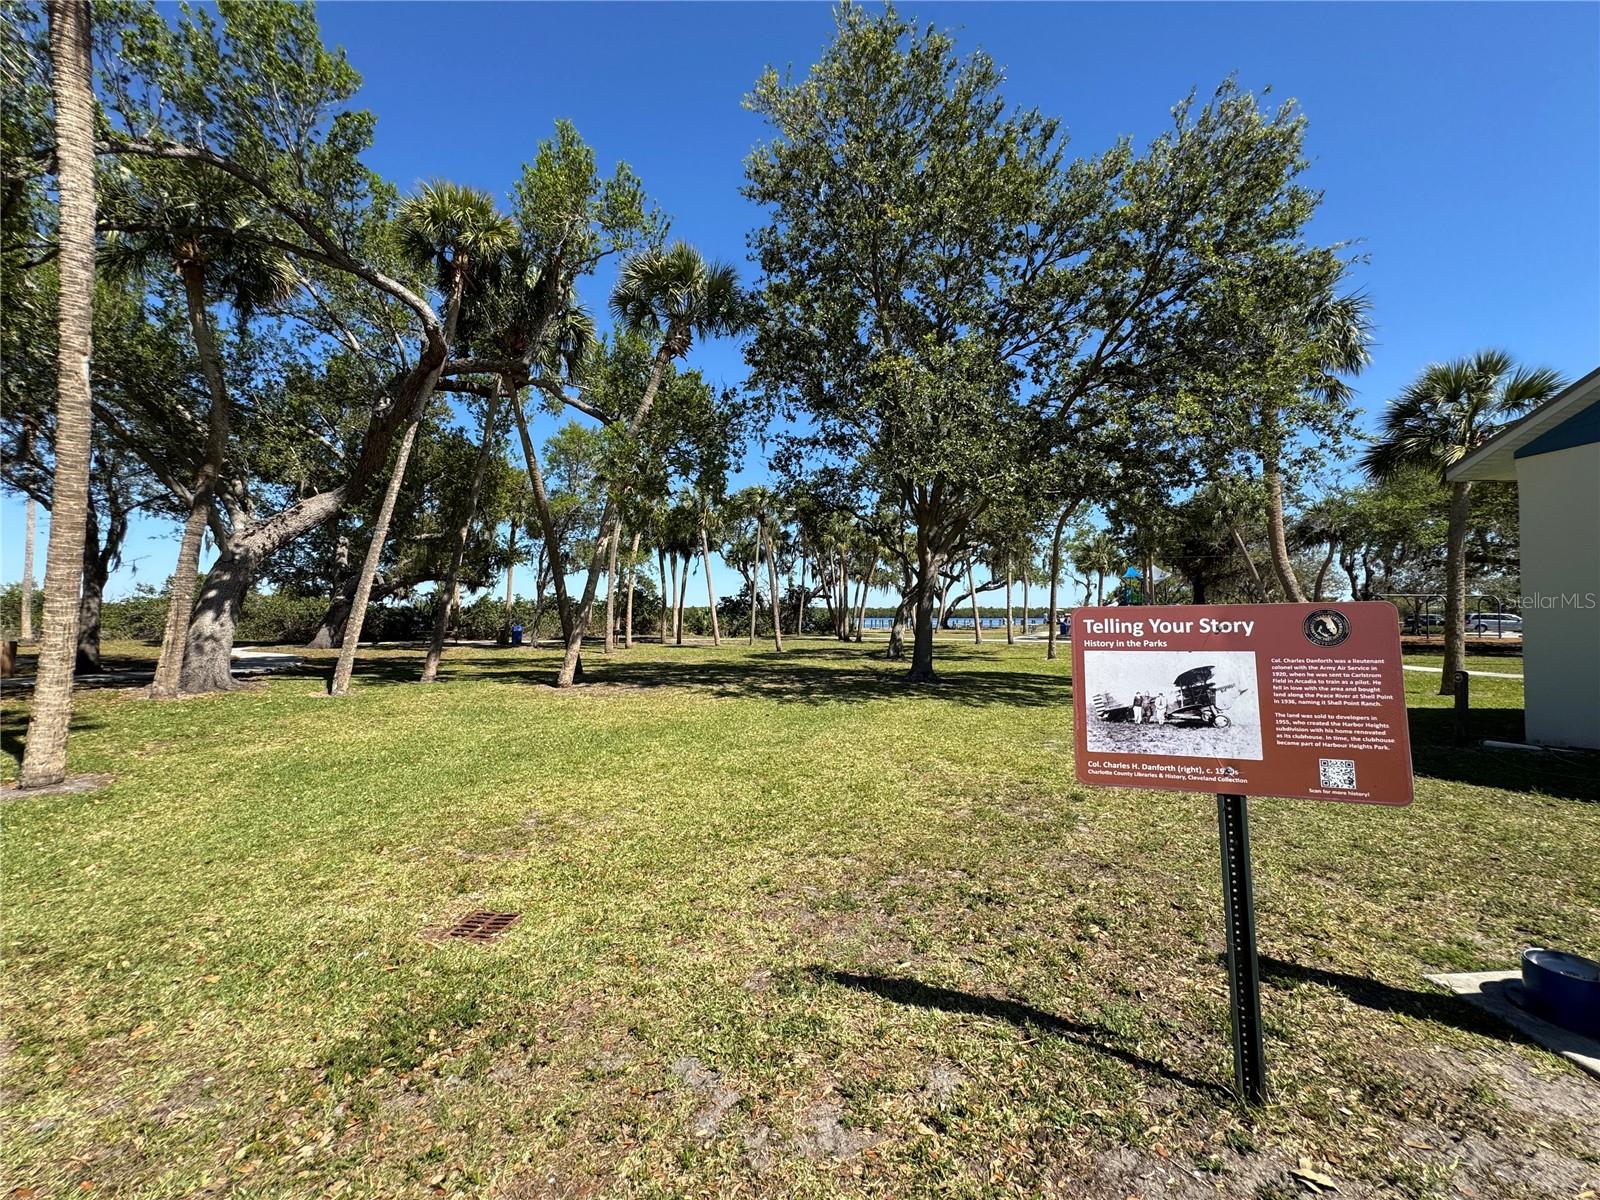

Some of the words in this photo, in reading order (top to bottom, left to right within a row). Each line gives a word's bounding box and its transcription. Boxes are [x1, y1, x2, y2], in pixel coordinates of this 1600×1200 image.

[1083, 619, 1144, 637] Telling
[1149, 619, 1193, 633] Your
[1199, 618, 1254, 636] Story
[1084, 640, 1114, 648] History
[1178, 765, 1204, 774] (right),
